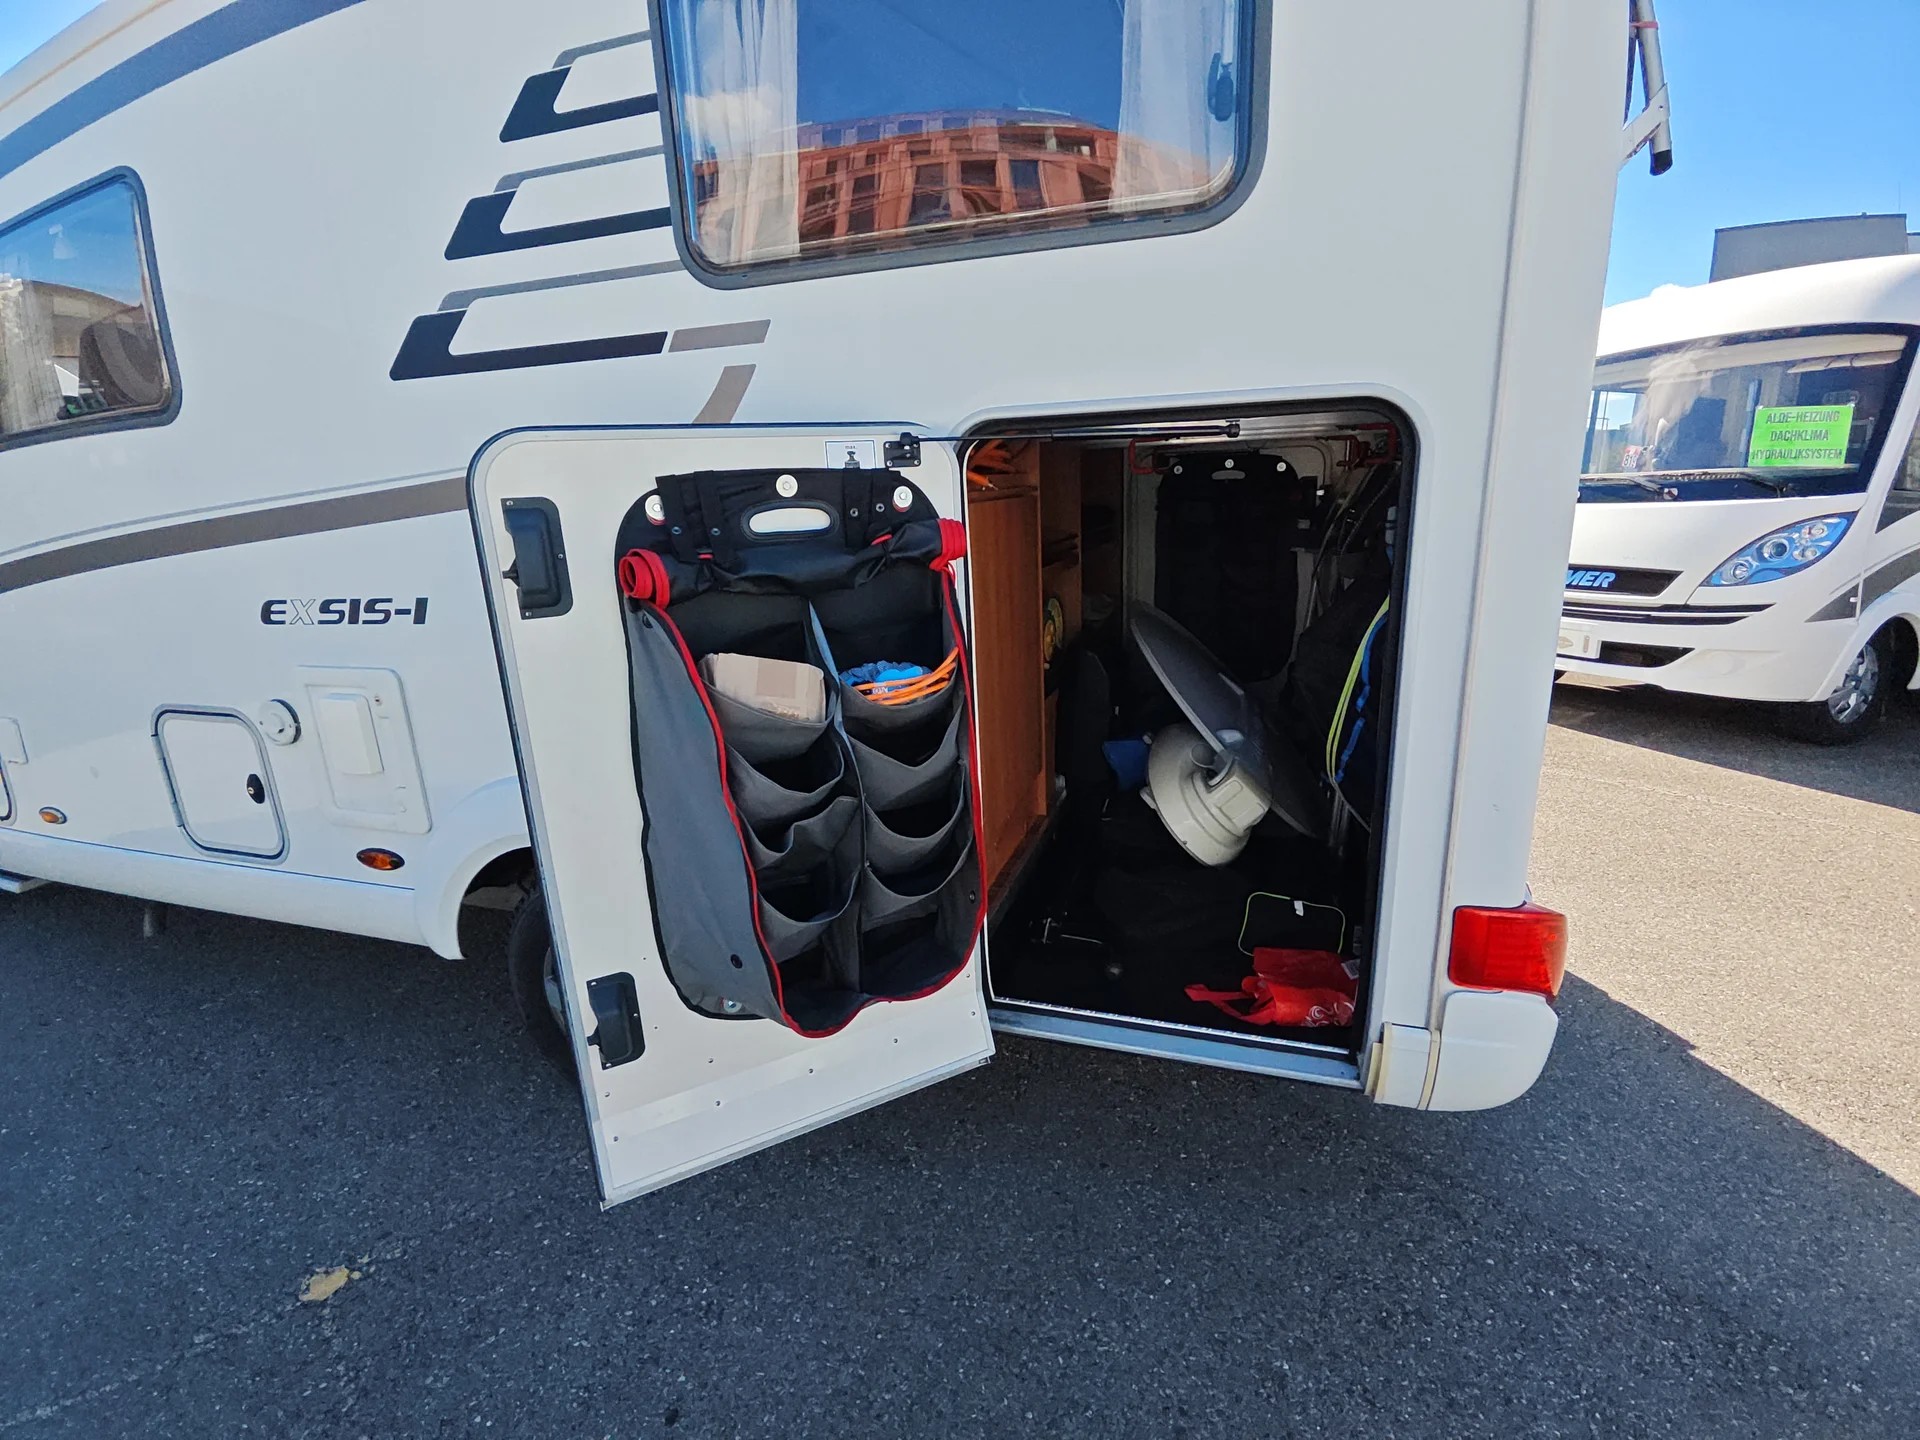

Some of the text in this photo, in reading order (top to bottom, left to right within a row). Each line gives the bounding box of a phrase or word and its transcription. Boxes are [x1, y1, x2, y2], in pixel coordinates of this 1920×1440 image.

[1766, 410, 1840, 424] ALDE-HEIZUNG
[1770, 429, 1829, 442] DACHKLIMA
[1752, 448, 1842, 460] HYDRAULIKSYSTEM
[1565, 570, 1616, 588] MER
[260, 597, 429, 625] EXSIS-I
